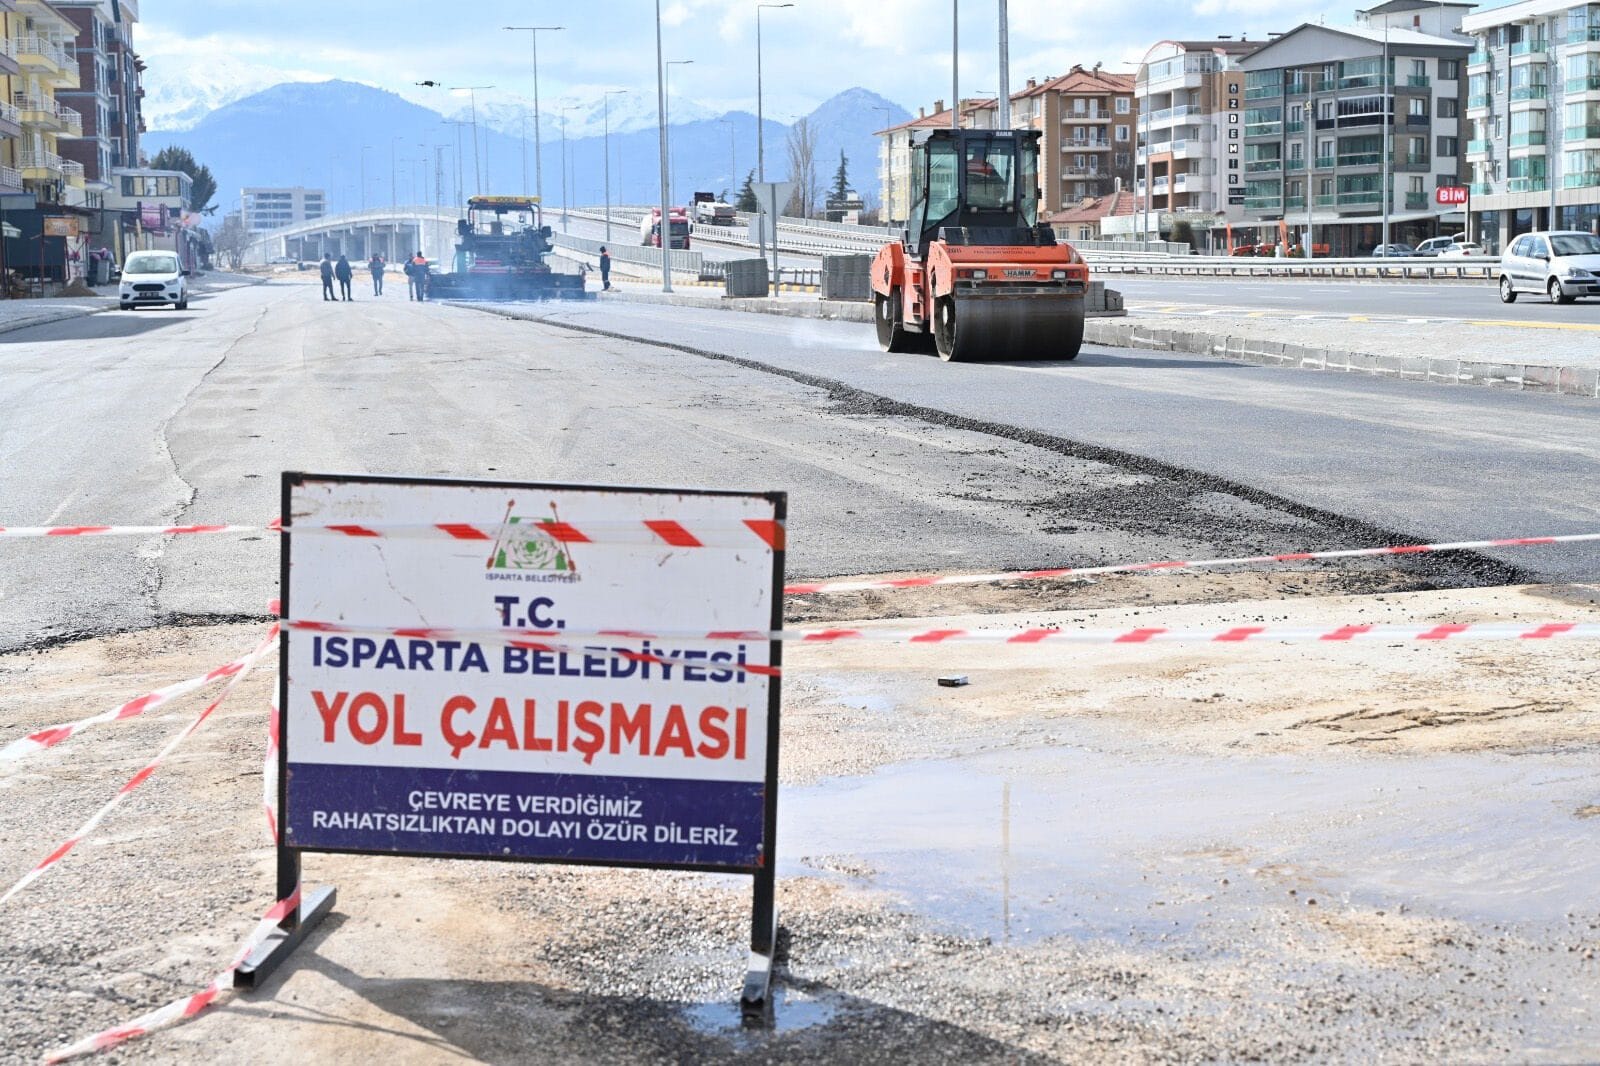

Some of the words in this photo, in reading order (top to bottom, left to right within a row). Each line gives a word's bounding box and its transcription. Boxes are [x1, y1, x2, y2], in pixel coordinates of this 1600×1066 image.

[1439, 187, 1465, 201] BİM
[485, 573, 522, 581] ISPARTA
[495, 596, 565, 629] T.C.
[313, 636, 489, 673] ISPARTA
[311, 691, 422, 746] YOL
[440, 695, 747, 765] ÇALIŞMASI
[408, 790, 511, 812] ÇEVREYE
[517, 793, 642, 818] VERDİĞİMİZ
[312, 811, 495, 835] RAHATSIZLIKTAN
[502, 818, 581, 839] DOLAYI
[587, 819, 647, 842] ÖZÜR
[654, 822, 738, 846] DİLERİZ
